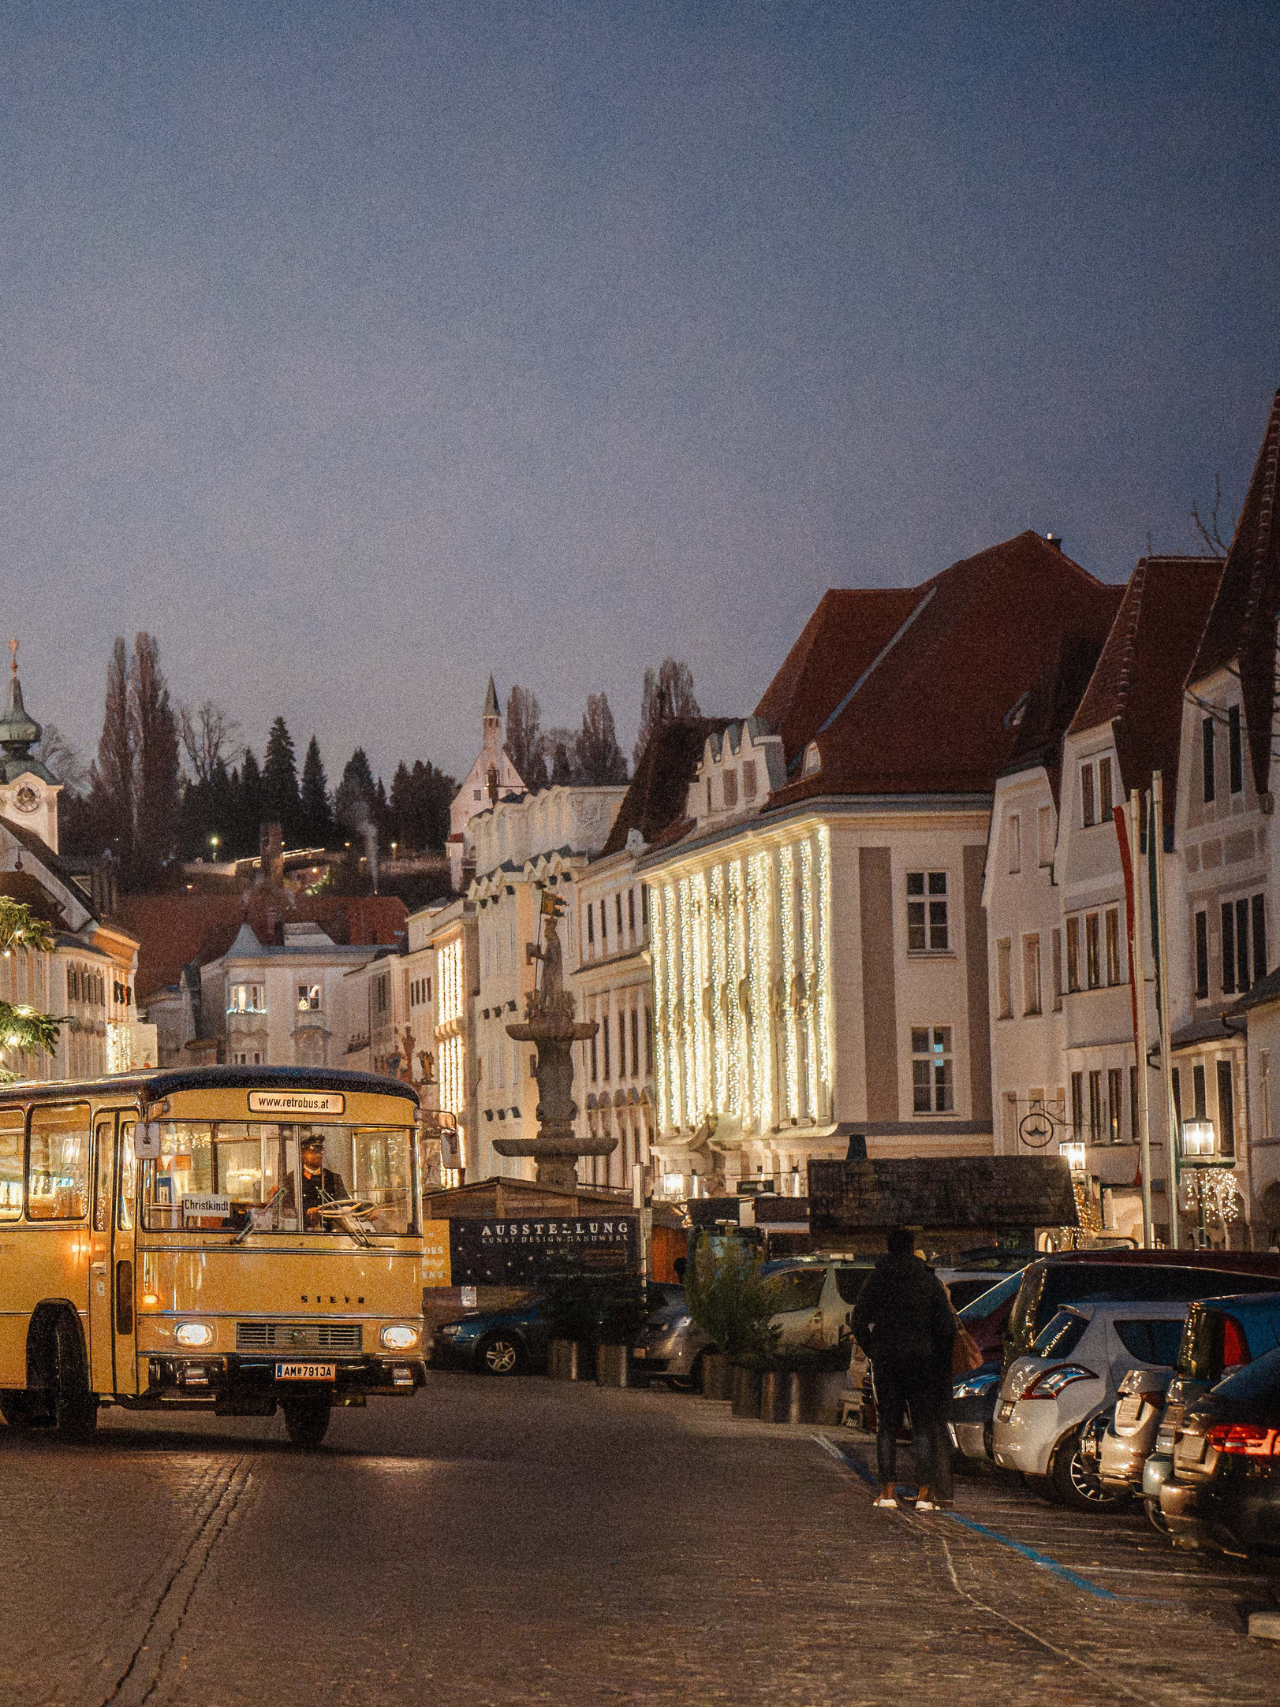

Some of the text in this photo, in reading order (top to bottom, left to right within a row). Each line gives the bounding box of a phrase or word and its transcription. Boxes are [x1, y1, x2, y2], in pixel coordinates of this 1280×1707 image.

[258, 1097, 329, 1109] www.retrobus.at
[481, 1222, 628, 1236] AUSSTELLUNG
[301, 1295, 365, 1304] STEYR
